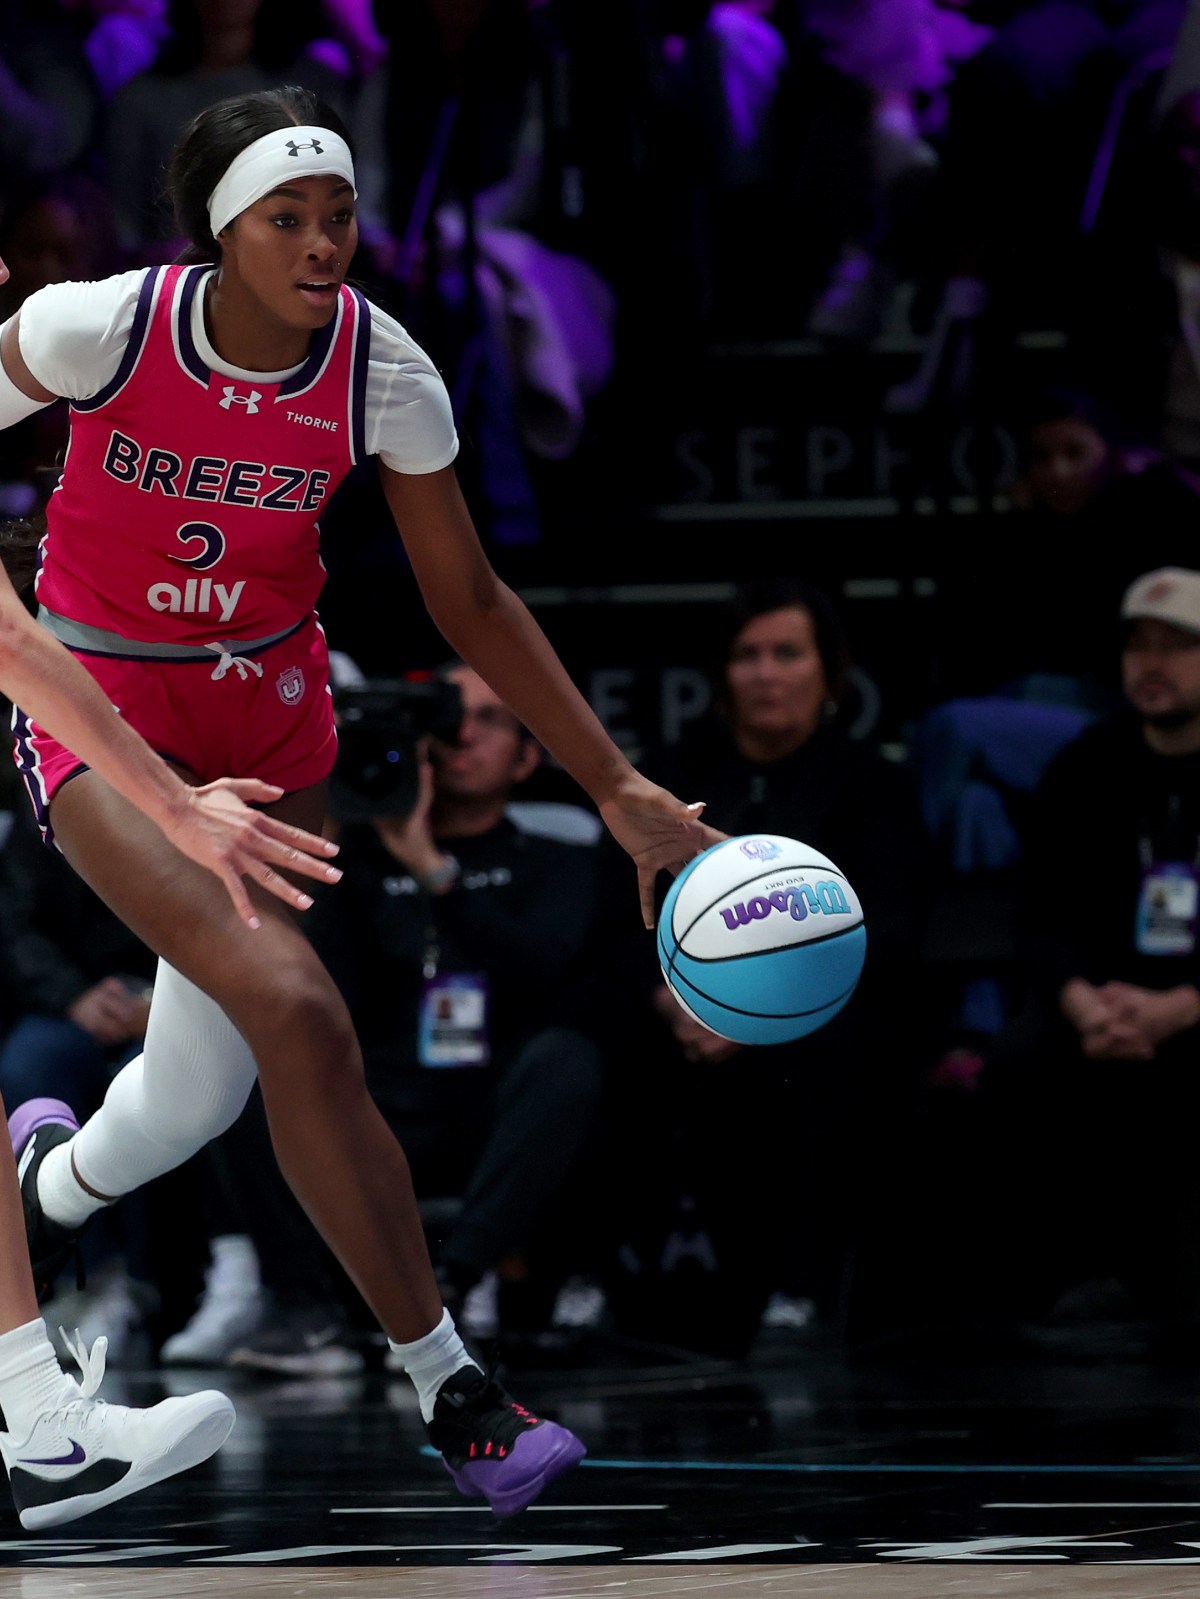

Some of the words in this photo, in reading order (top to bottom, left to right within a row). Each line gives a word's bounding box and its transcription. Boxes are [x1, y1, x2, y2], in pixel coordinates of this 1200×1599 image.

[286, 411, 339, 432] THORNE
[103, 430, 331, 512] BREEZE
[147, 578, 247, 622] ally
[719, 880, 852, 930] Wilson
